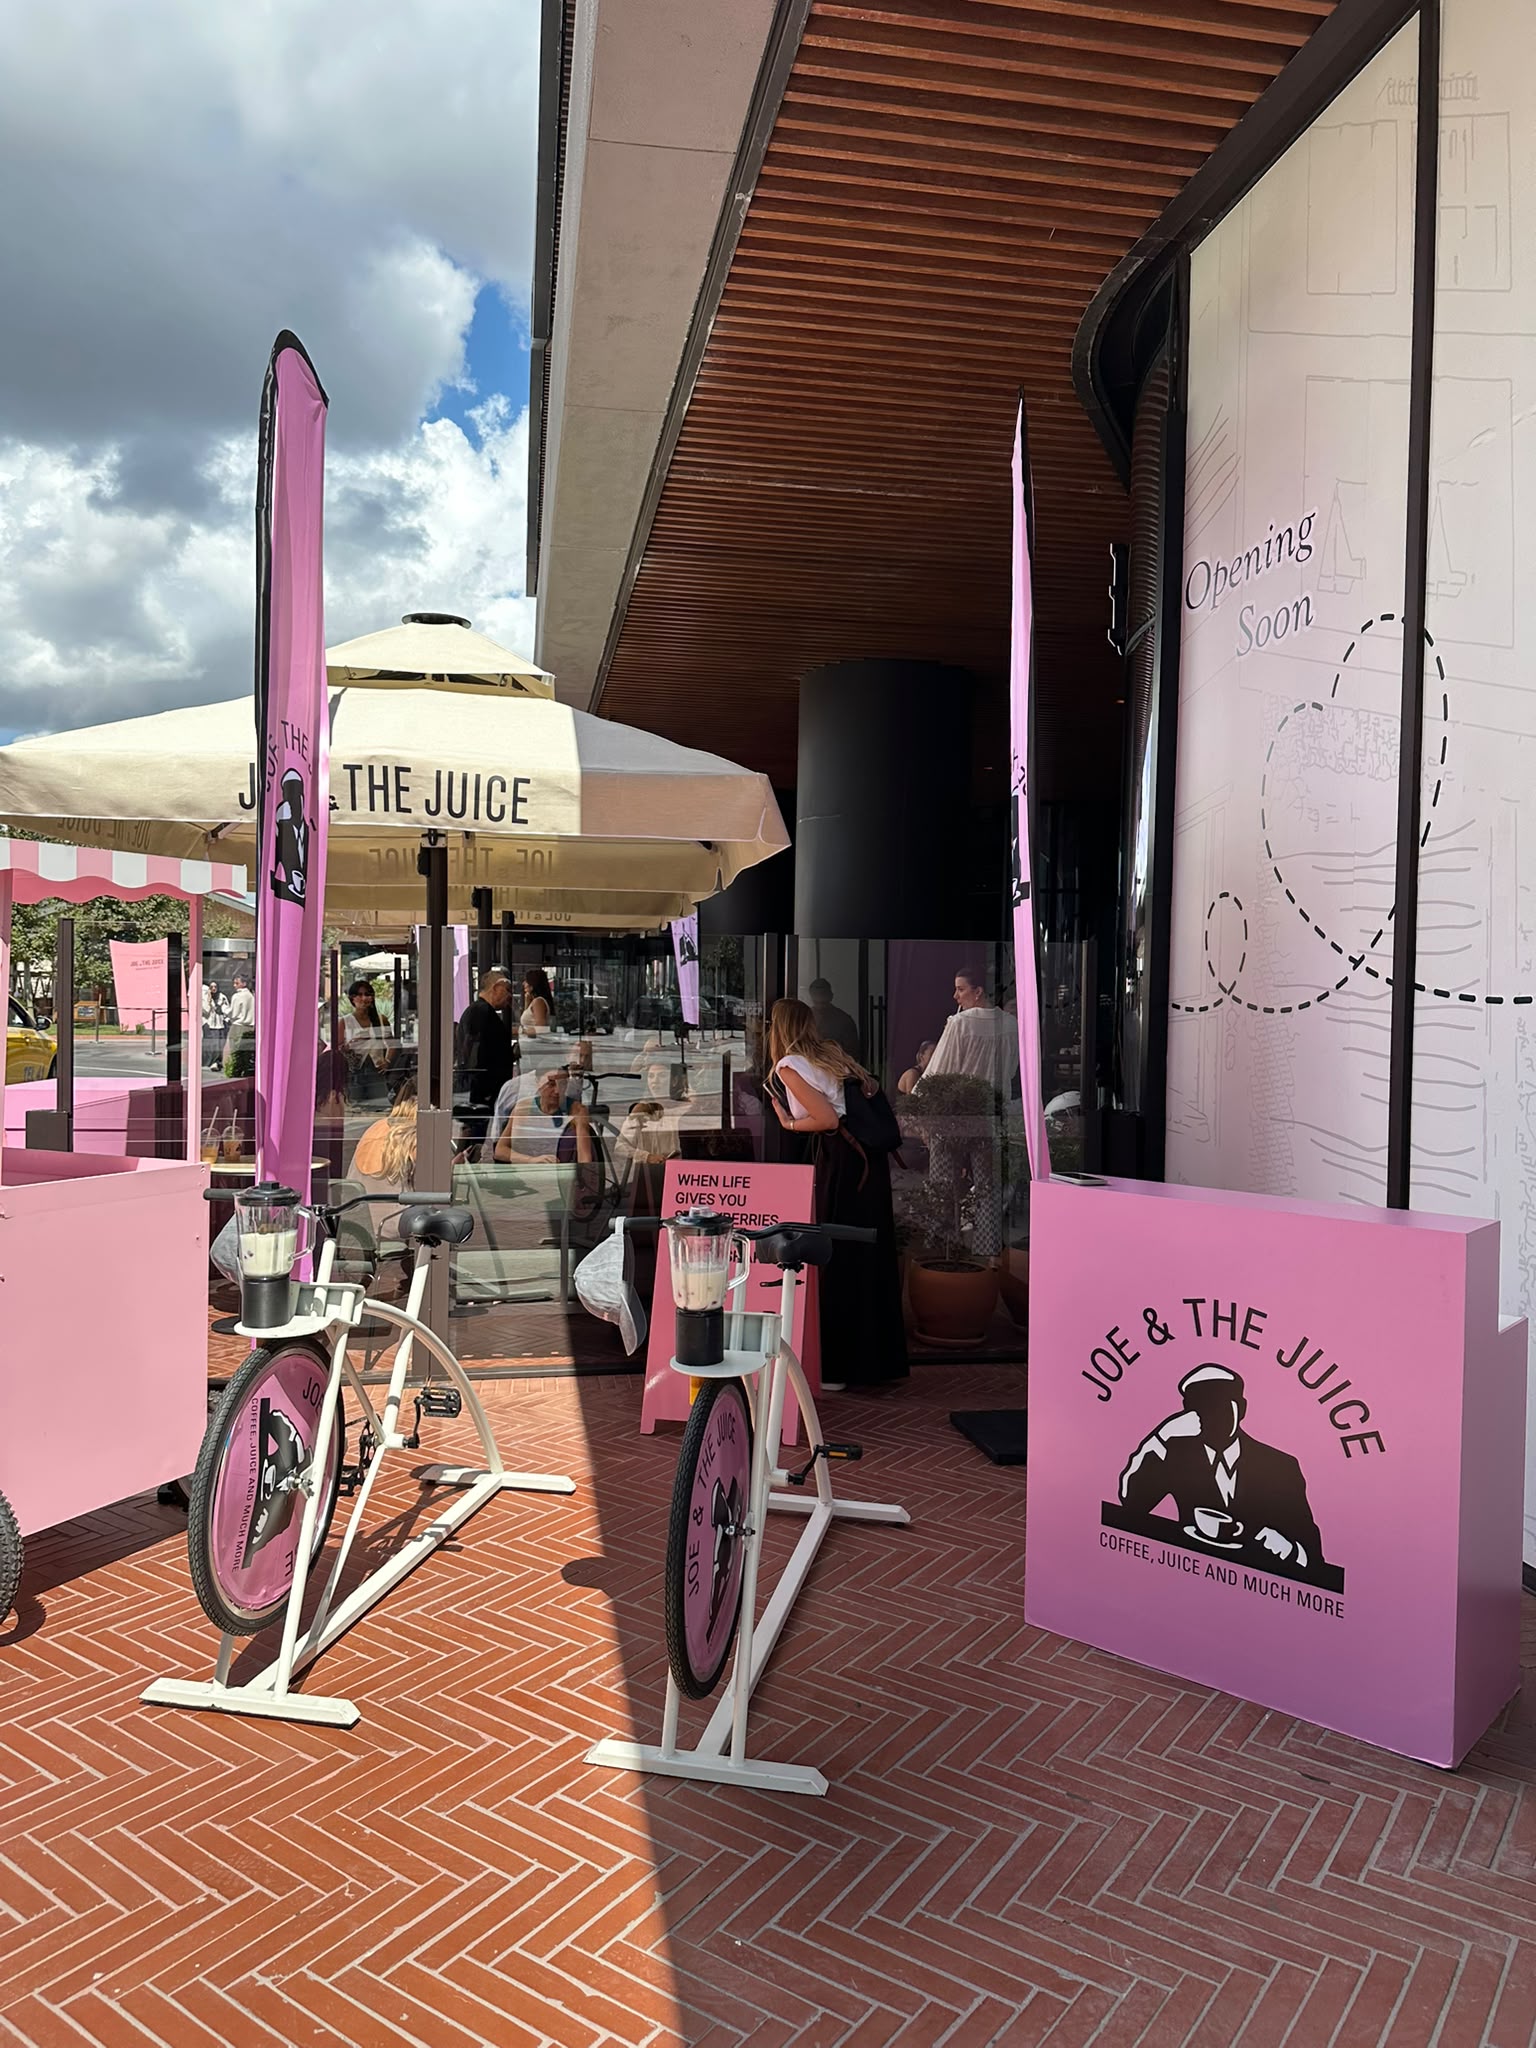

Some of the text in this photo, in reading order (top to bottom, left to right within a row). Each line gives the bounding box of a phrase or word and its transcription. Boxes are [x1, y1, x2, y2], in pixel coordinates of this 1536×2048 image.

[1185, 512, 1317, 610] Opening
[1235, 595, 1313, 657] Soon
[281, 719, 309, 762] THE
[343, 763, 413, 814] THE
[425, 769, 531, 825] JUICE
[675, 1191, 747, 1207] GIVES YOU
[677, 1173, 751, 1189] WHEN LIFE
[1081, 1298, 1387, 1459] JOE & THE JUICE
[249, 1443, 257, 1475] JUICE
[246, 1477, 256, 1501] AND
[688, 1412, 736, 1598] JOE & THE JUICE
[238, 1504, 252, 1538] MUCH
[232, 1540, 244, 1573] MORE
[1099, 1531, 1346, 1619] COFFEE, JUICE AND MUCH MORE
